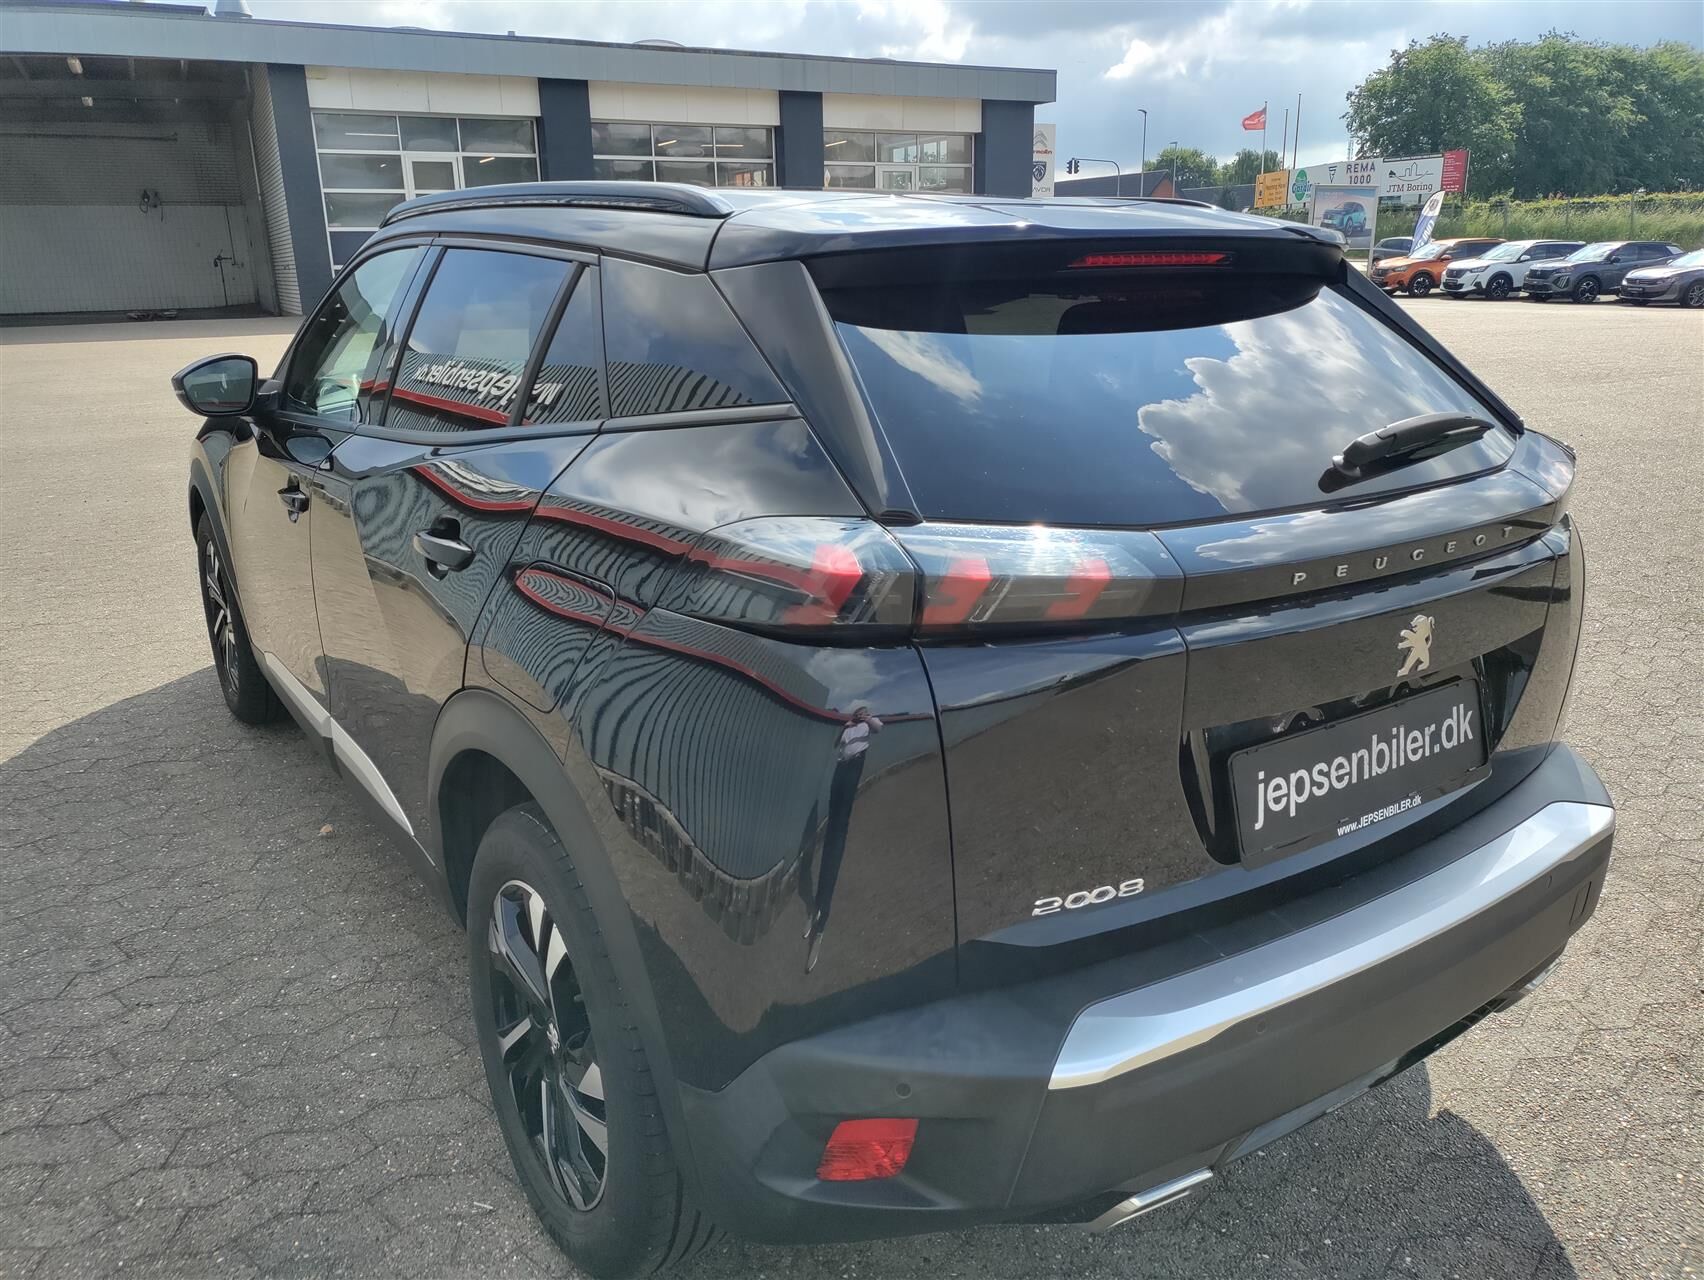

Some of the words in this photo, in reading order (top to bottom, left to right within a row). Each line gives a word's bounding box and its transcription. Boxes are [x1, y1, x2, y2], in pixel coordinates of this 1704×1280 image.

[1346, 162, 1376, 174] REMA
[1349, 174, 1371, 185] 1000
[1387, 183, 1405, 193] JTM
[1407, 183, 1433, 192] Boring
[1293, 526, 1513, 586] PEUGEOT
[1254, 703, 1474, 831] jepsenbiler.dk
[1337, 795, 1422, 837] www.JEPSENBILER.dk
[1031, 878, 1145, 917] 2008
